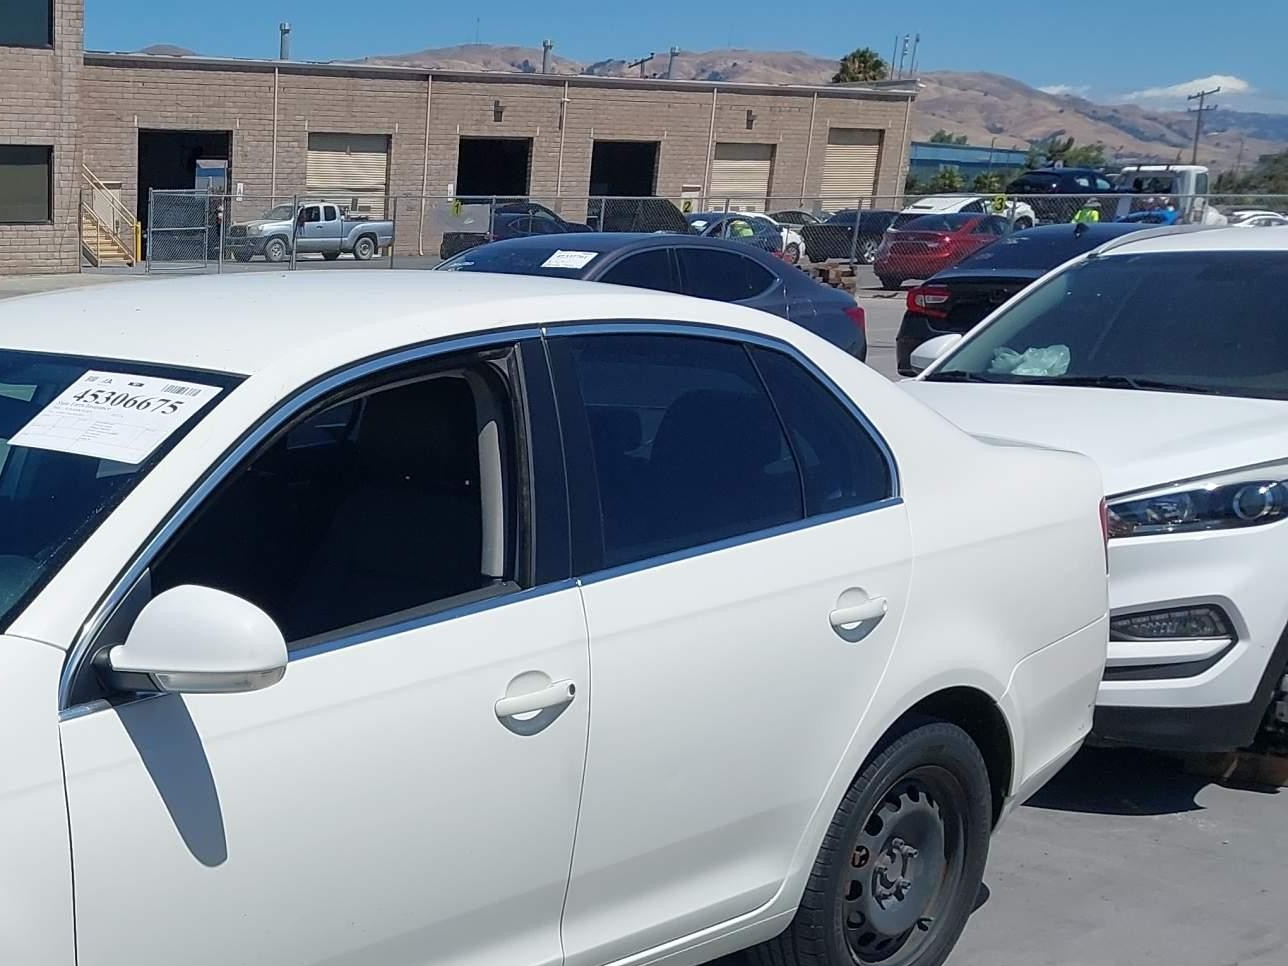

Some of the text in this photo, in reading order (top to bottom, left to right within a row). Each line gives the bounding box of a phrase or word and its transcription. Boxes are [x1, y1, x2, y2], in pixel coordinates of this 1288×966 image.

[683, 201, 692, 213] 2
[994, 197, 1004, 211] 3
[72, 388, 184, 415] 45306675
